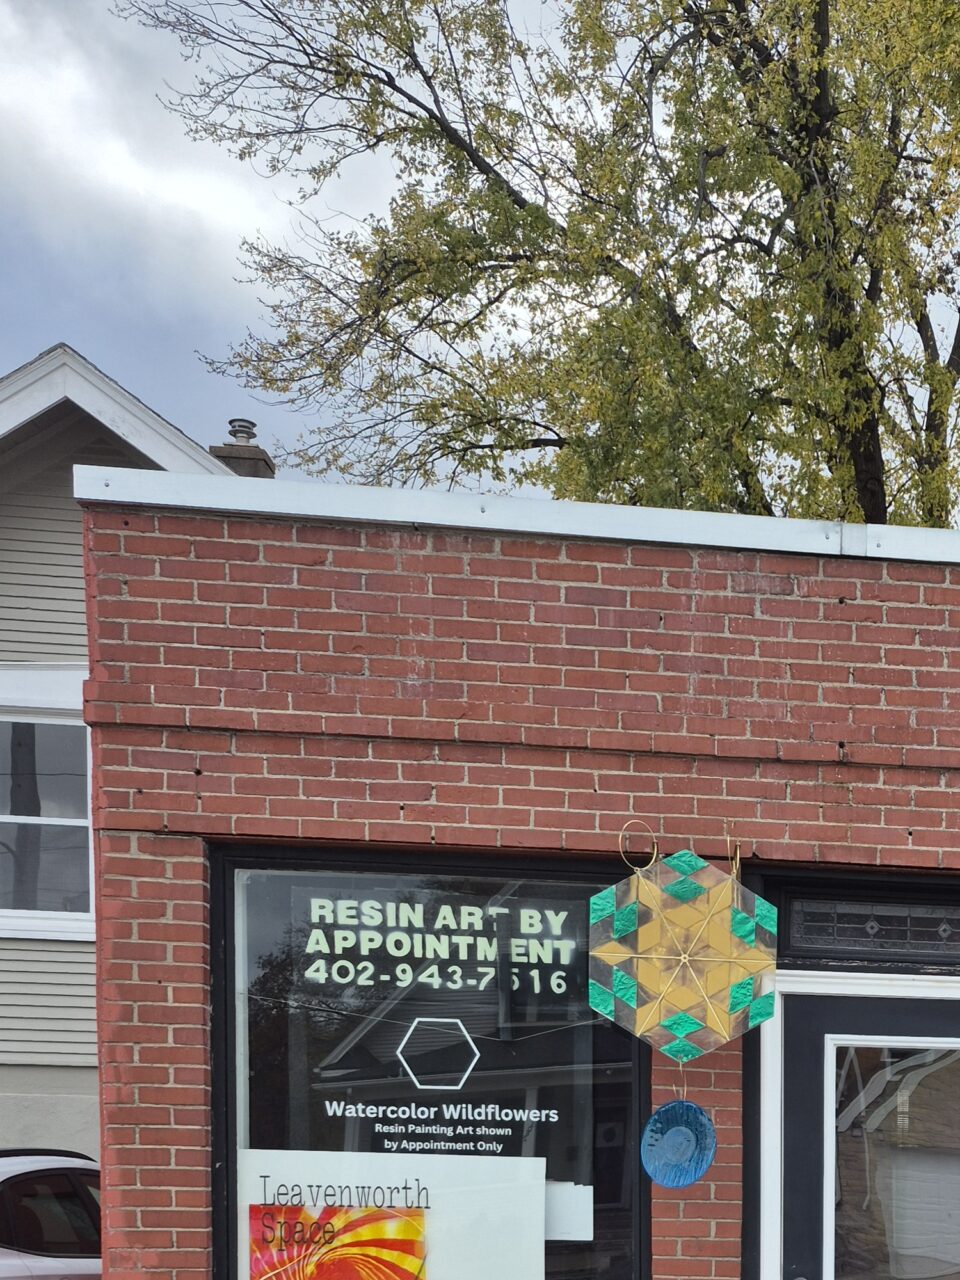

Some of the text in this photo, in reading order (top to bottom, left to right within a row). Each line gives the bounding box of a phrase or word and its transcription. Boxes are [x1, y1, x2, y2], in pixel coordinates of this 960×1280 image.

[310, 898, 568, 936] RESIN ART BY
[305, 928, 576, 965] APPOINTMENT
[325, 1100, 559, 1122] Watercolor Wildflowers
[375, 1123, 512, 1137] Resin Painting Art shown
[384, 1139, 503, 1153] by Appointment Only
[259, 1175, 431, 1209] Leavenworth
[261, 1212, 335, 1251] Space
